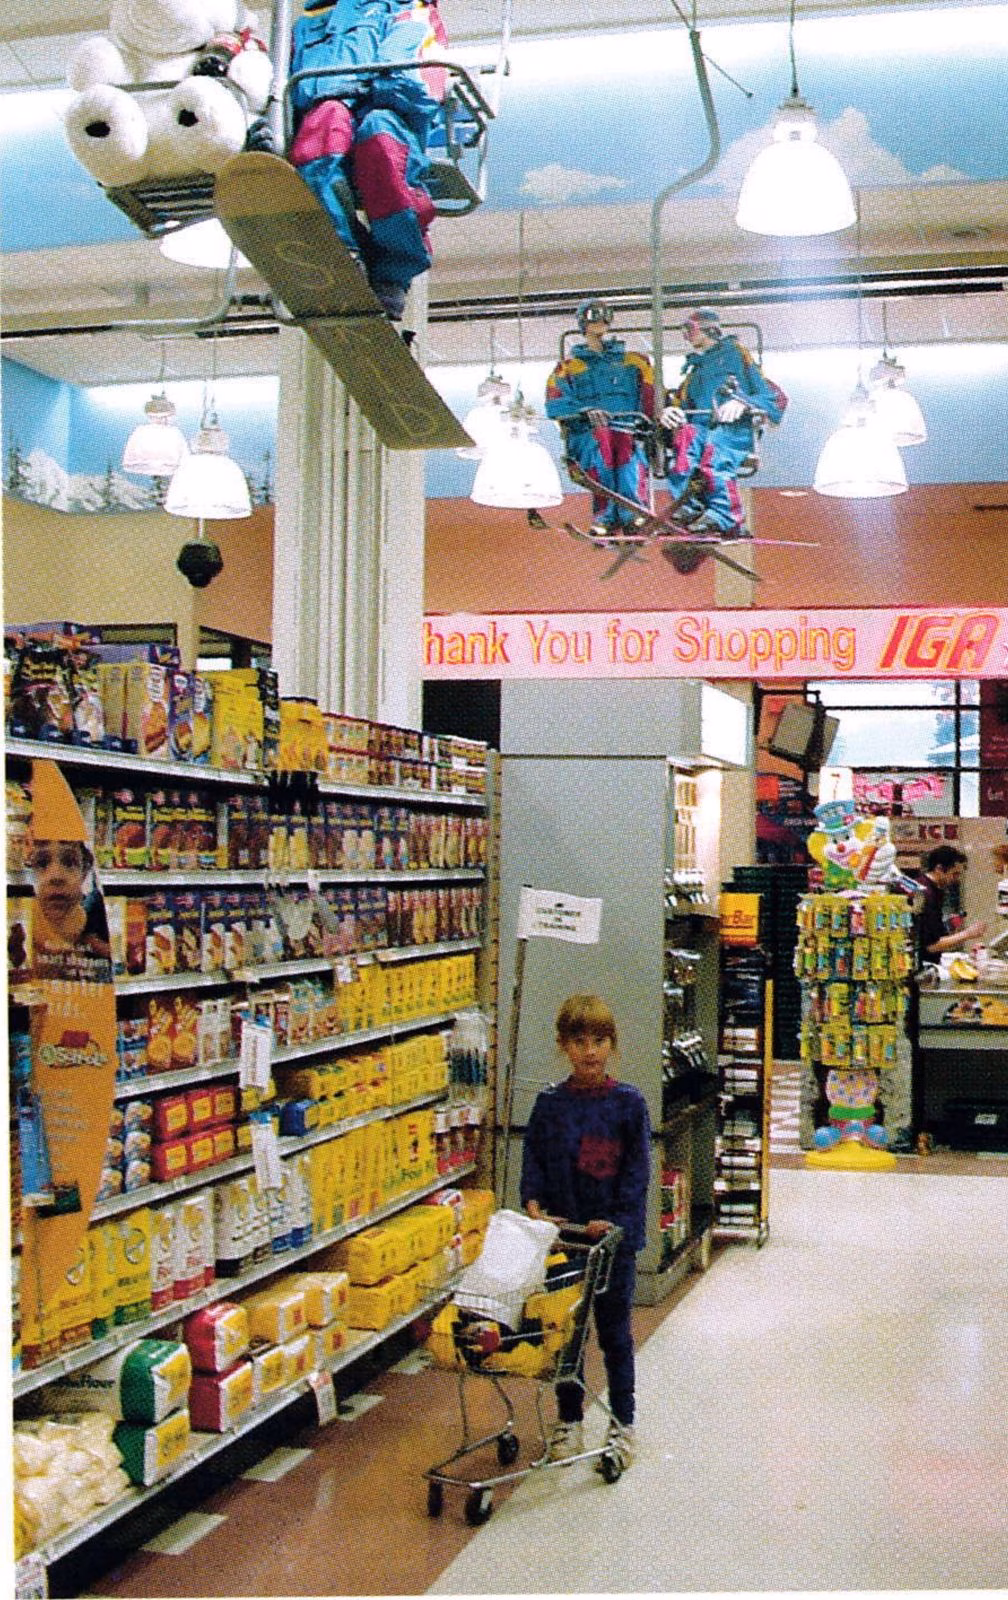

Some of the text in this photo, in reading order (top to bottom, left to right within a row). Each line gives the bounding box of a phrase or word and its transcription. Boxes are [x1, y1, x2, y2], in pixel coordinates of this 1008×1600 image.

[423, 611, 999, 673] hank You for Shopping IGA
